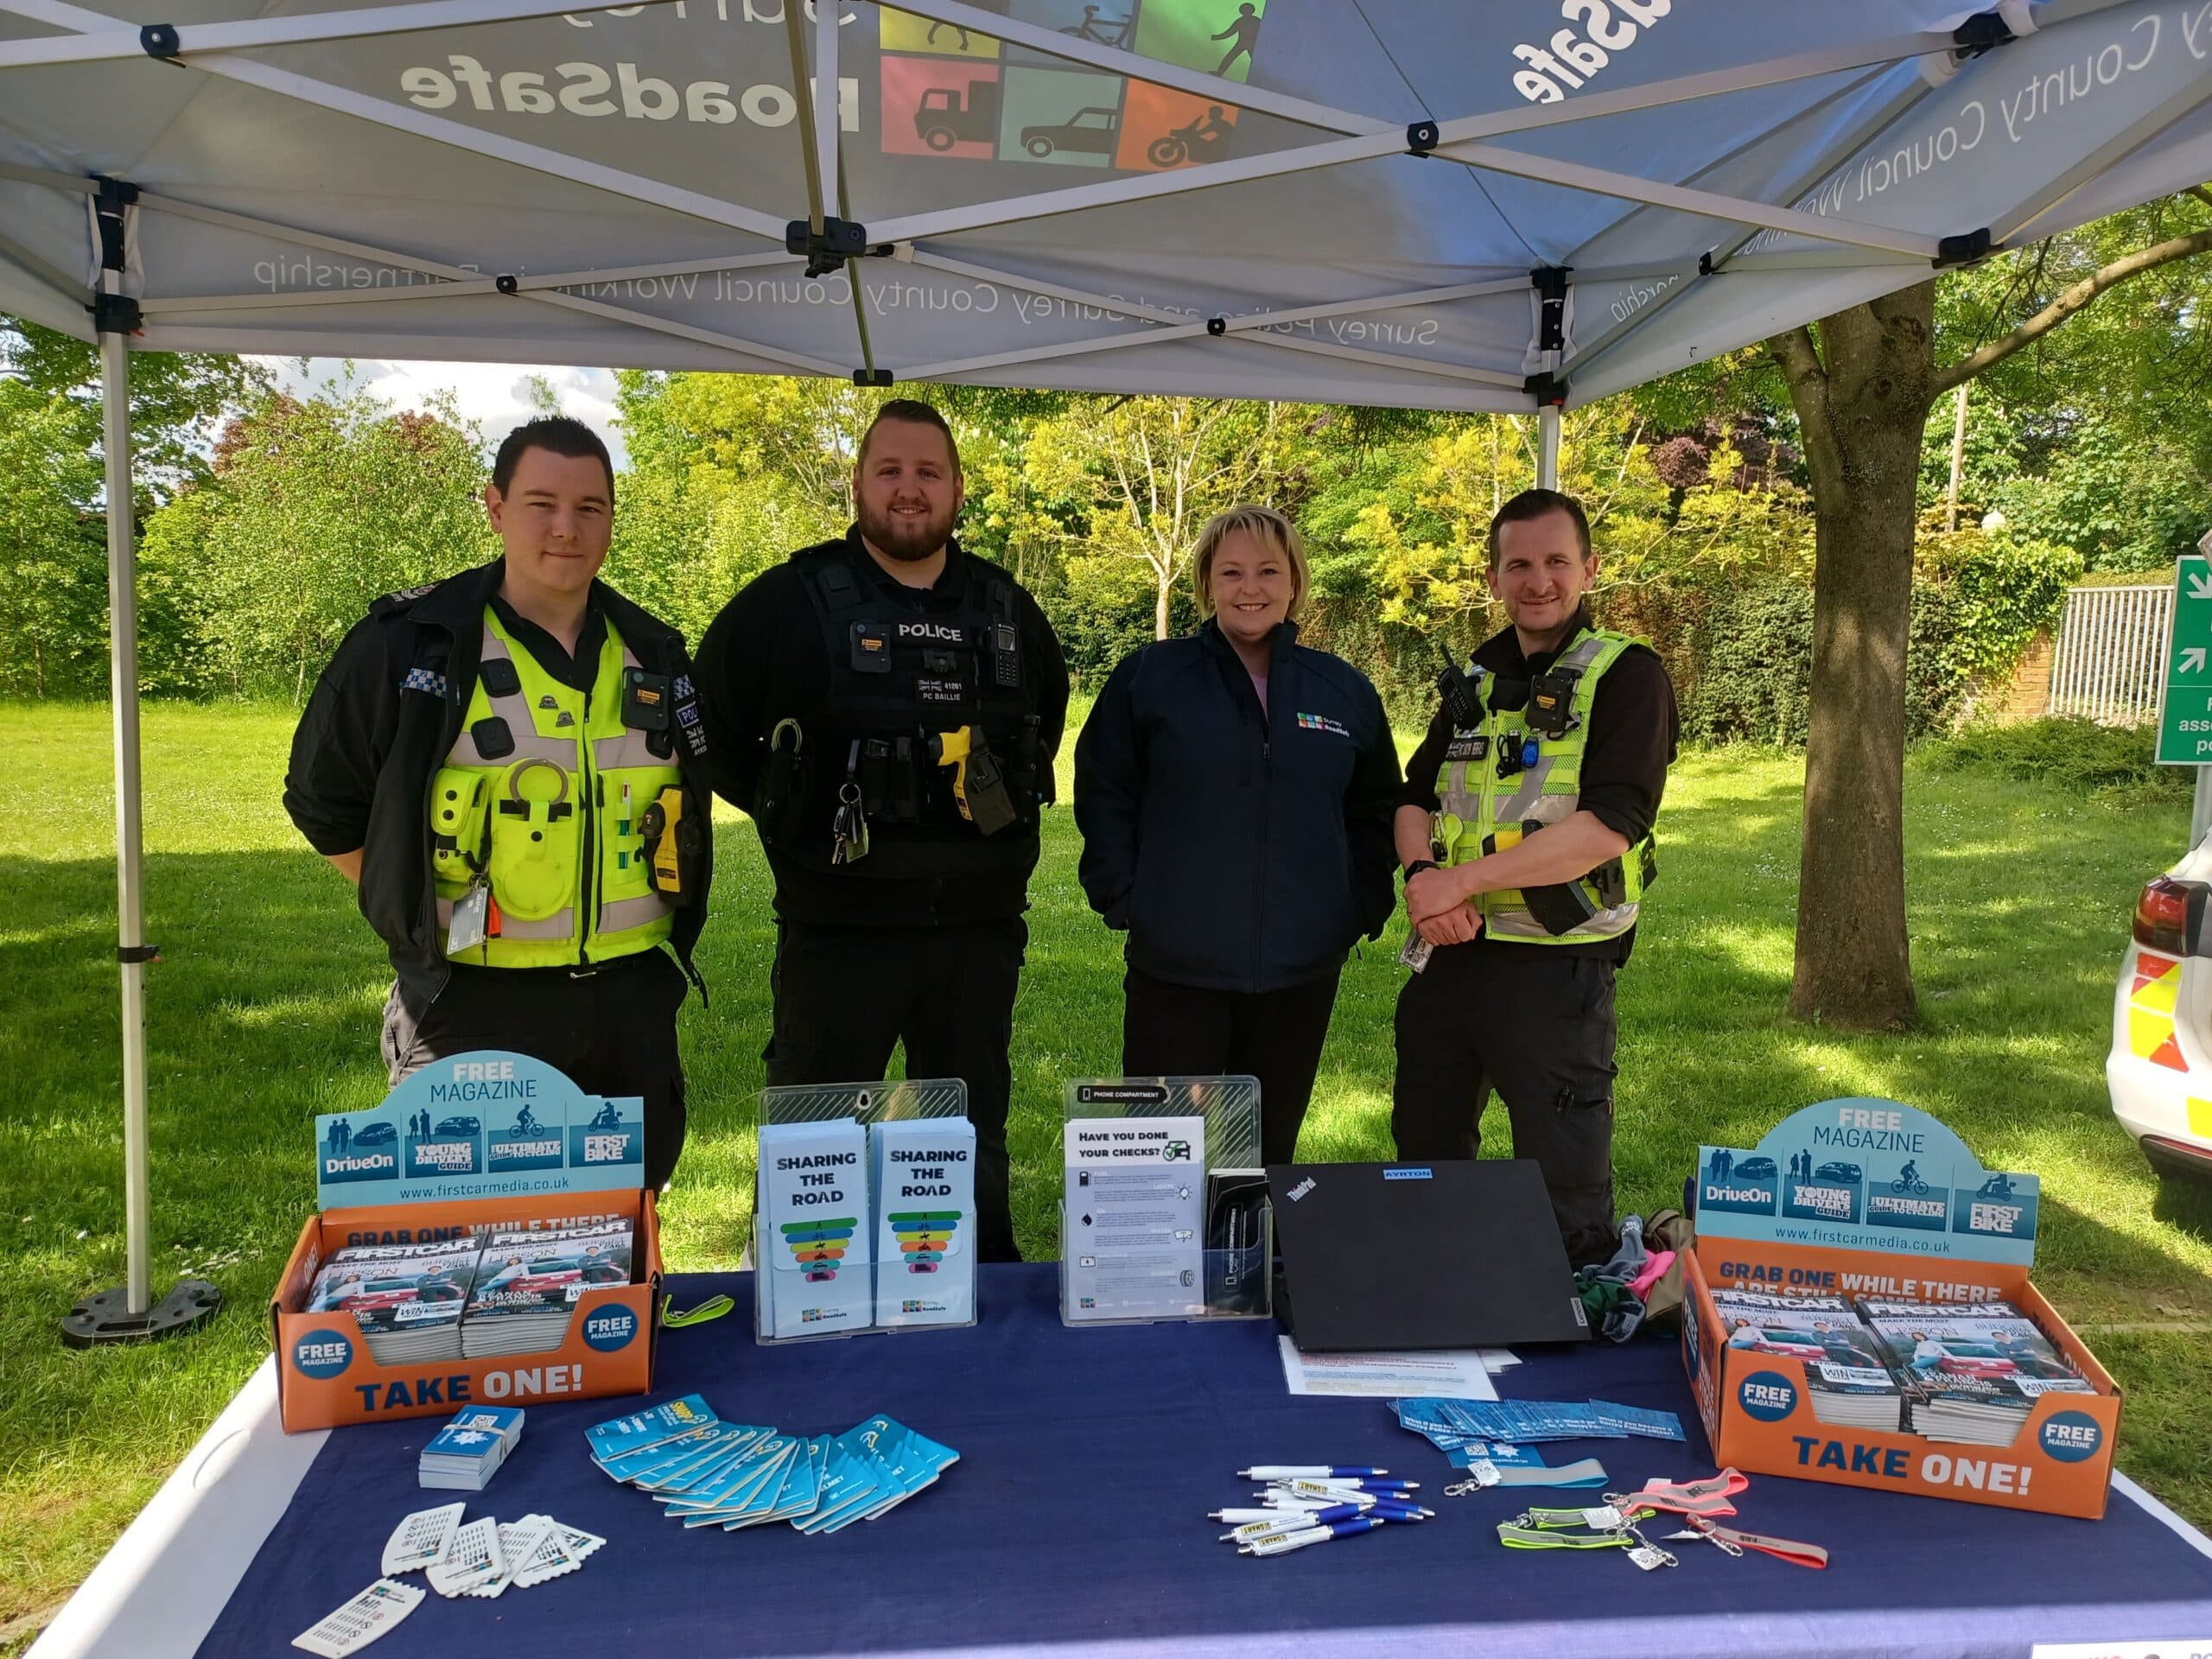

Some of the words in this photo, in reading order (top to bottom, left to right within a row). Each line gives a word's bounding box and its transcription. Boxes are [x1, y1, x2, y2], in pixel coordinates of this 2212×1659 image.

[899, 623, 963, 642] POLICE
[923, 692, 933, 701] PC
[934, 693, 962, 702] BAILLIE
[453, 1060, 514, 1082] FREE
[430, 1078, 537, 1103] MAGAZINE
[1115, 1090, 1160, 1099] COMPARTMENT
[1838, 1107, 1903, 1132] FREE
[584, 1133, 631, 1150] FIRST
[1113, 1132, 1135, 1141] YOU
[1138, 1131, 1169, 1141] DONE
[1814, 1126, 1925, 1154] MAGAZINE
[415, 1142, 472, 1156] YOUNG
[496, 1141, 562, 1154] ULTIMATE
[584, 1146, 624, 1163] BIKE
[1079, 1148, 1110, 1158] YOUR
[1112, 1147, 1160, 1158] CHECKS?
[777, 1152, 857, 1171] SHARING
[890, 1150, 967, 1163] SHARING
[438, 1162, 473, 1171] GUIDE
[911, 1167, 944, 1180] THE
[400, 1176, 569, 1200] www.firstcarmedia.co.uk
[799, 1173, 835, 1187] THE
[791, 1190, 844, 1206] ROAD
[901, 1185, 952, 1198] ROAD
[1794, 1185, 1851, 1201] YOUNG
[1875, 1196, 1946, 1211] ULTIMATE
[1971, 1203, 2024, 1220] FIRST
[1816, 1207, 1850, 1219] GUIDE
[1906, 1209, 1945, 1217] CYCLING
[493, 1218, 628, 1246] FIRSTCAR
[1969, 1216, 2013, 1233] BIKE
[347, 1229, 412, 1247] GRAB
[1775, 1225, 1951, 1255] www.firstcarmedia.co.uk
[335, 1238, 479, 1262] FIRSTCAR
[1719, 1262, 1784, 1283] GRAB
[1789, 1268, 1836, 1289] ONE
[1840, 1272, 1917, 1296] WHILE
[1923, 1280, 2002, 1302] THERE
[1709, 1289, 1845, 1311] FIRSTCAR
[1867, 1302, 2016, 1318] FIRSTCAR
[587, 1316, 632, 1333] FREE
[590, 1329, 630, 1341] MAGAZINE
[297, 1343, 346, 1360] FREE
[302, 1355, 345, 1366] MAGAZINE
[1823, 1368, 1850, 1380] WIN
[355, 1376, 471, 1412] TAKE
[483, 1363, 582, 1400] ONE!
[1743, 1382, 1791, 1404] FREE
[1746, 1397, 1787, 1411] MAGAZINE
[2044, 1424, 2096, 1443] FREE
[2047, 1437, 2092, 1450] MAGAZINE
[1792, 1435, 1911, 1479] TAKE
[1920, 1453, 2033, 1496] ONE!
